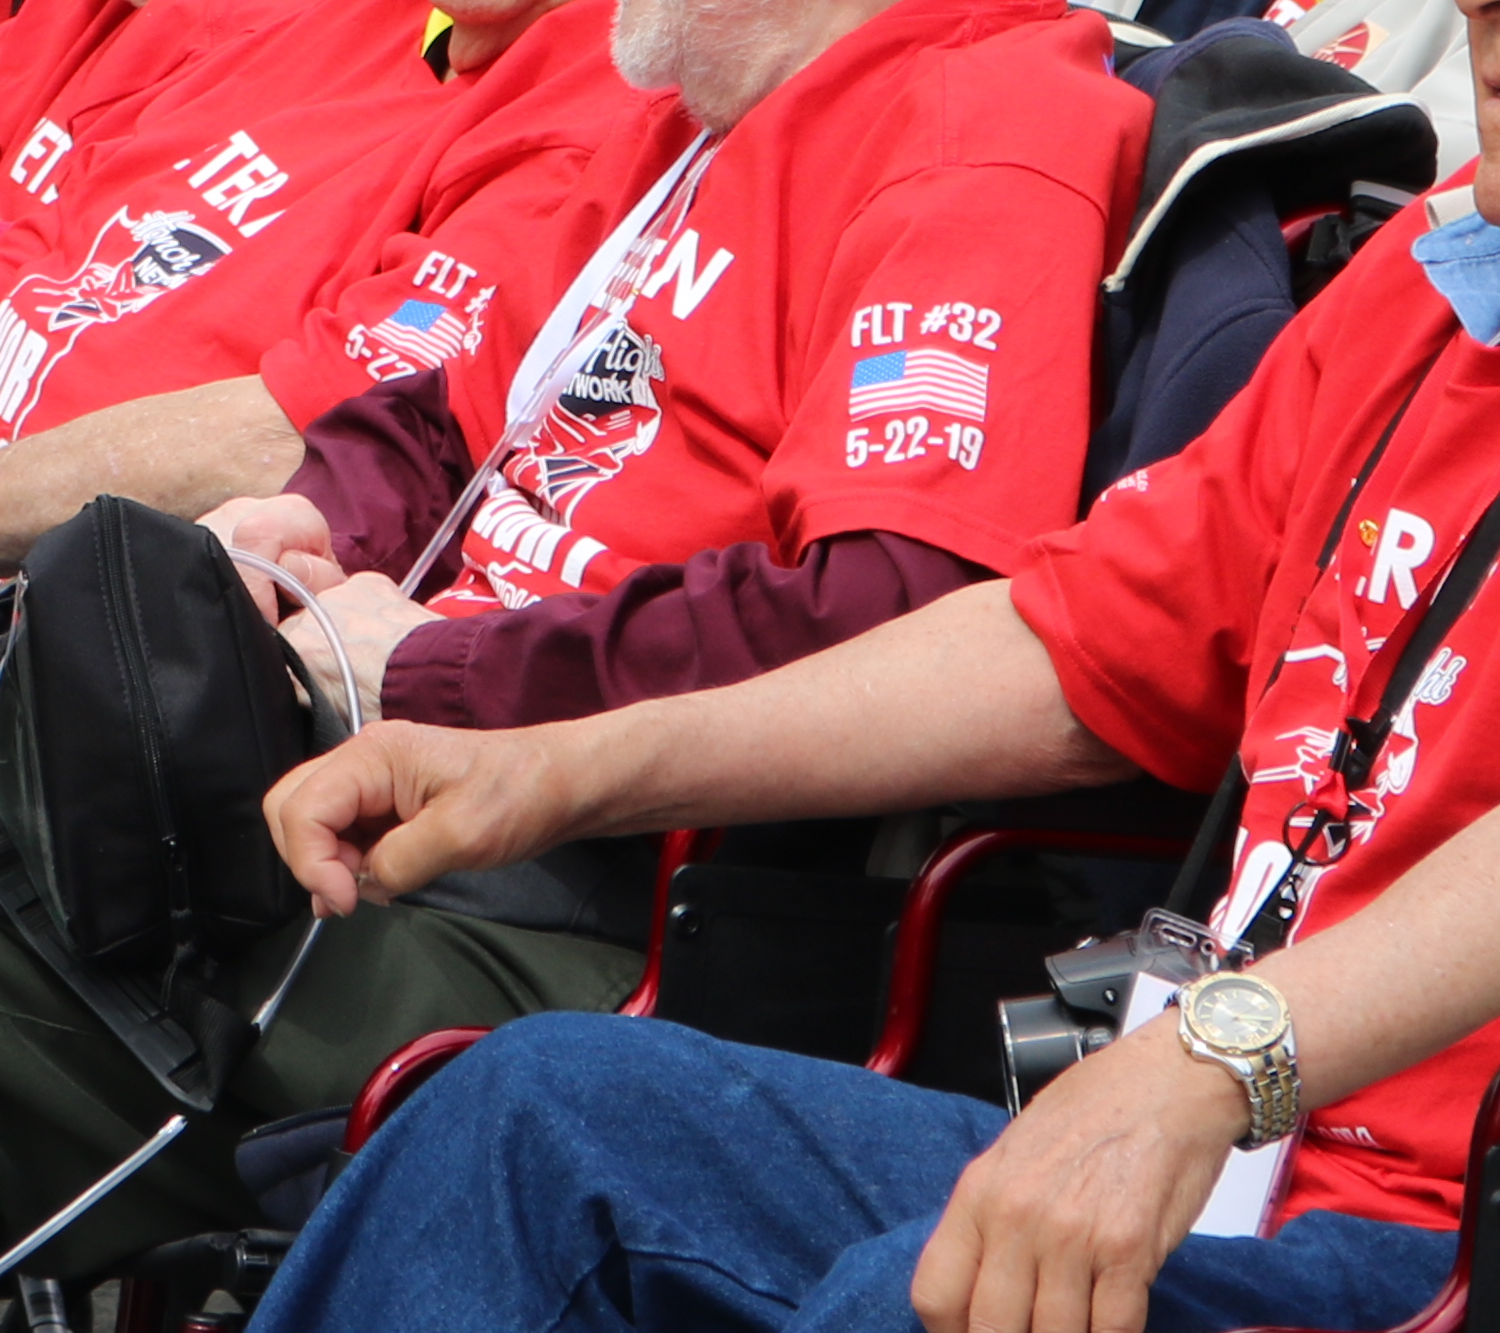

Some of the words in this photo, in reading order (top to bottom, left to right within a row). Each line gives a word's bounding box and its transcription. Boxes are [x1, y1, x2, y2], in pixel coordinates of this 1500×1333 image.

[412, 250, 478, 300] FLT
[850, 301, 913, 348] FLT
[919, 301, 1003, 351] #32
[563, 372, 636, 405] TWORK
[845, 415, 986, 472] 5-22-19
